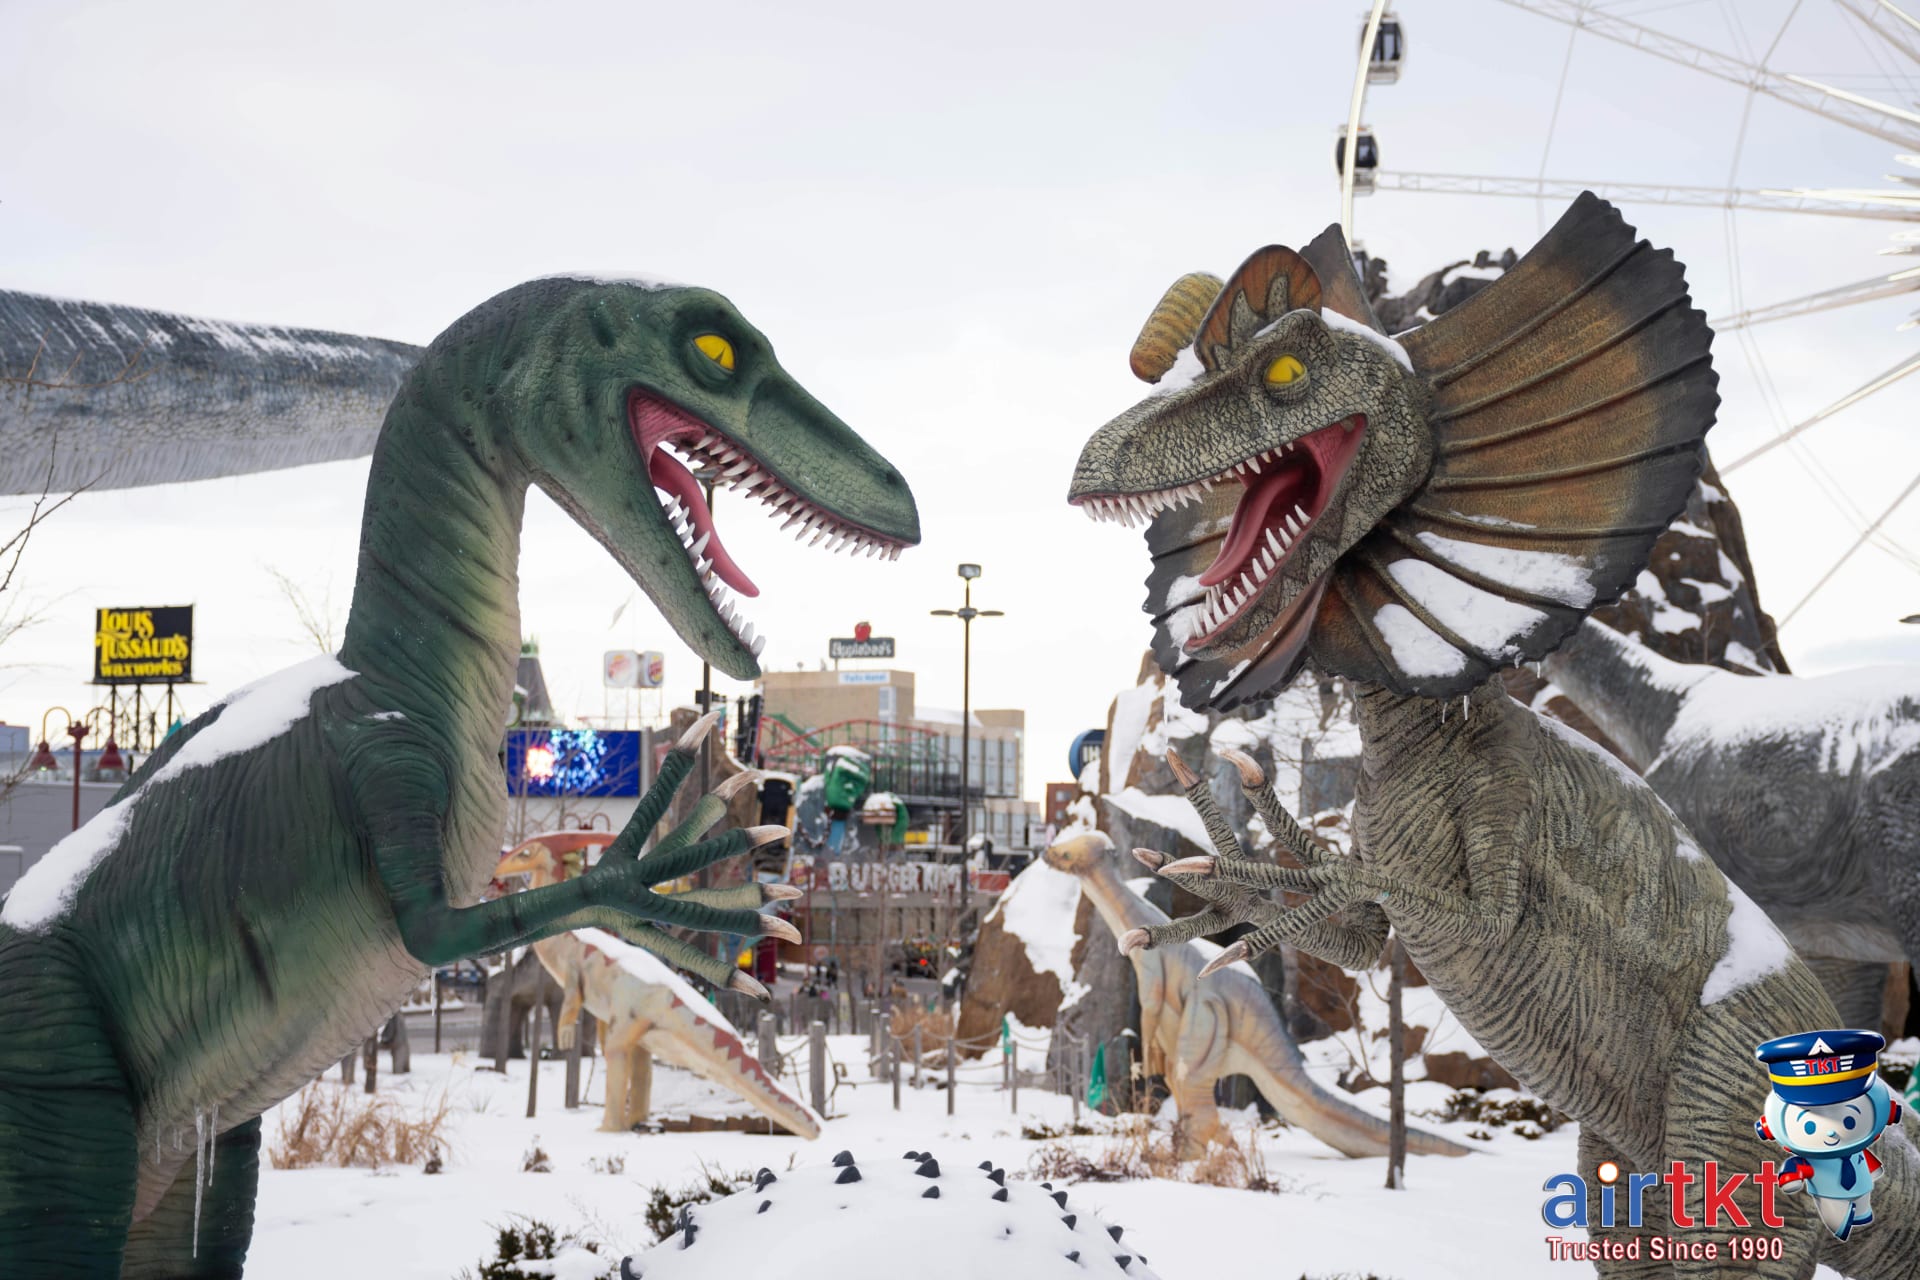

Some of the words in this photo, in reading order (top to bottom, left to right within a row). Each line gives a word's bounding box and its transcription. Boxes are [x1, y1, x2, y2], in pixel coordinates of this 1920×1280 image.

[101, 608, 154, 639] LOUIS
[831, 641, 892, 657] Applebee's
[101, 659, 183, 677] waxworks
[1083, 745, 1100, 762] IH
[828, 862, 920, 892] BURGER
